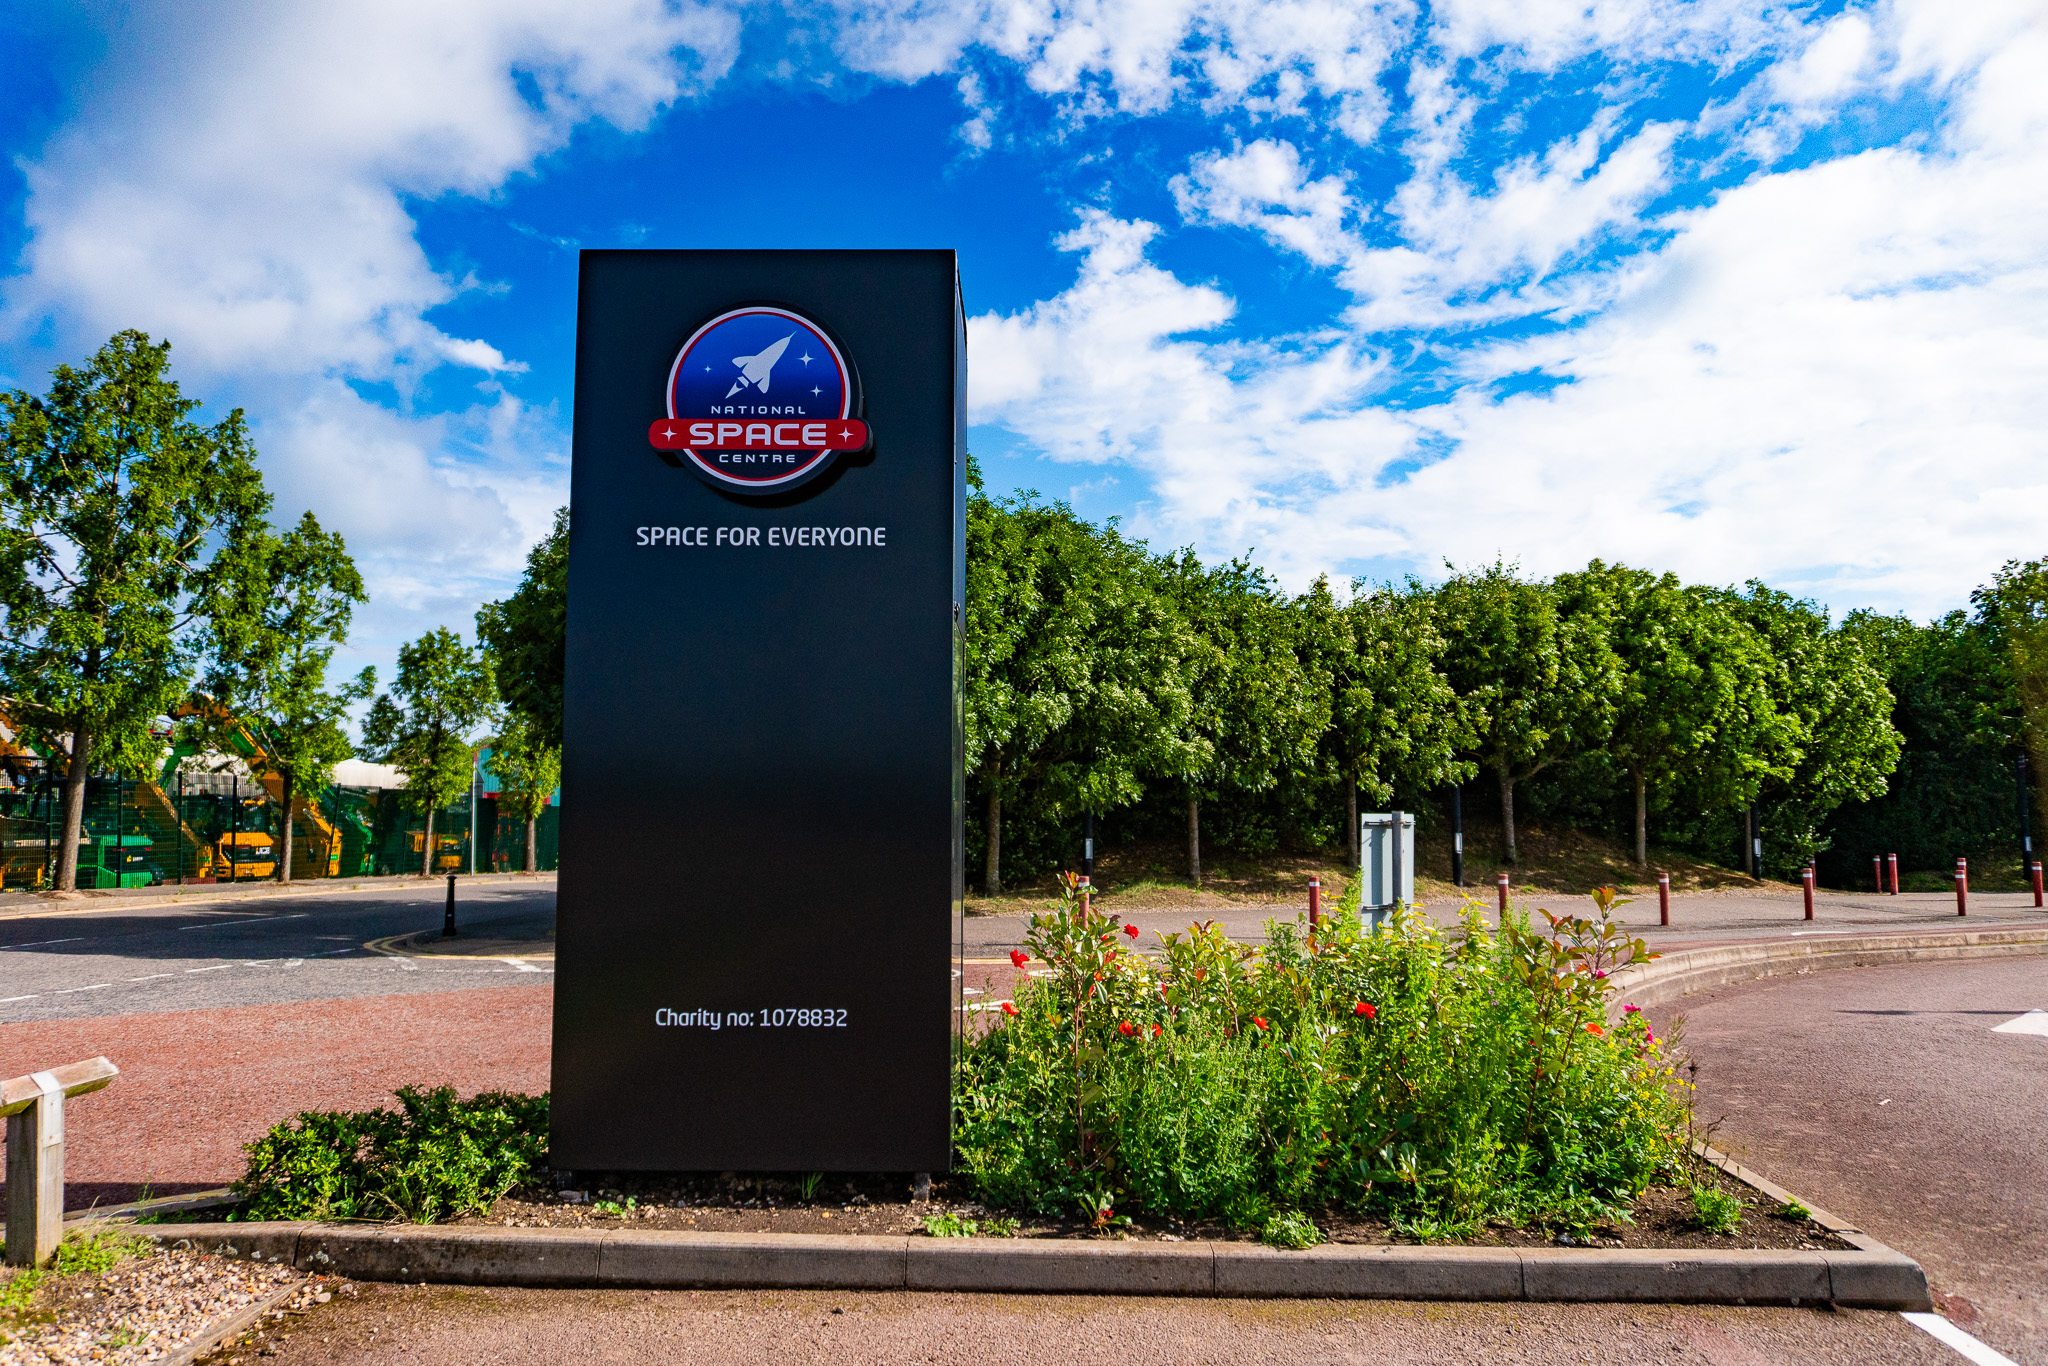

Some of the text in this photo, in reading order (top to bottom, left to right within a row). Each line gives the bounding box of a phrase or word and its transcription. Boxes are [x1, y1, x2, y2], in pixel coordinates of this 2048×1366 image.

[711, 405, 806, 415] NATIONAL
[689, 423, 827, 446] SPACE
[719, 454, 796, 463] CENTRE
[636, 526, 886, 547] SPACE FOR EVERYONE
[655, 1008, 848, 1031] Charity no: 1078832
